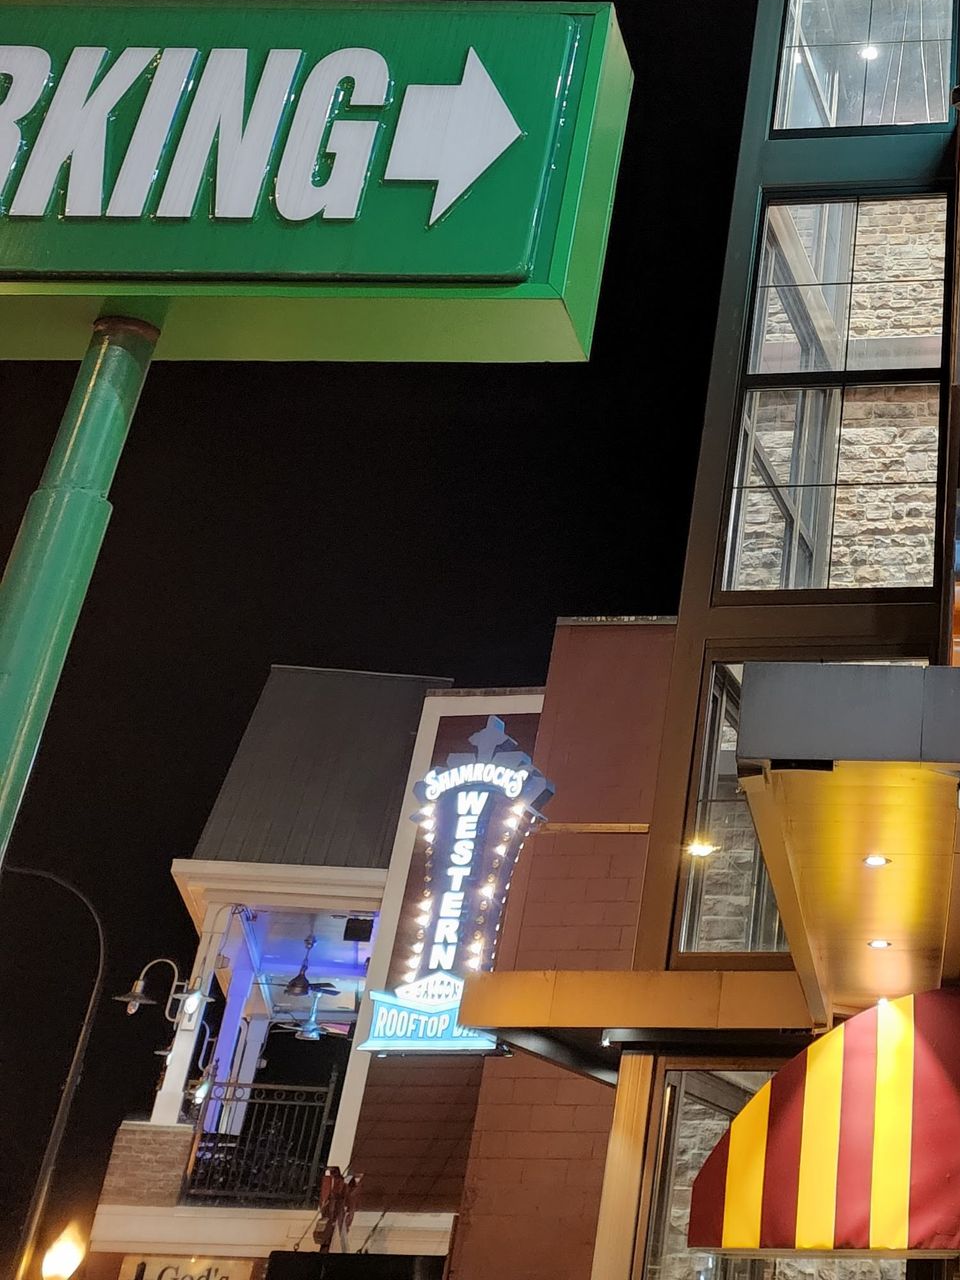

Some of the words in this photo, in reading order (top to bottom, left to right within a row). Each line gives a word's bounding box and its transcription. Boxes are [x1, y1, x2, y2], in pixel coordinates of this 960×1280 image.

[423, 762, 529, 801] SHAMROCKS
[427, 790, 489, 971] WESTERN
[374, 1005, 450, 1038] ROOFTOP
